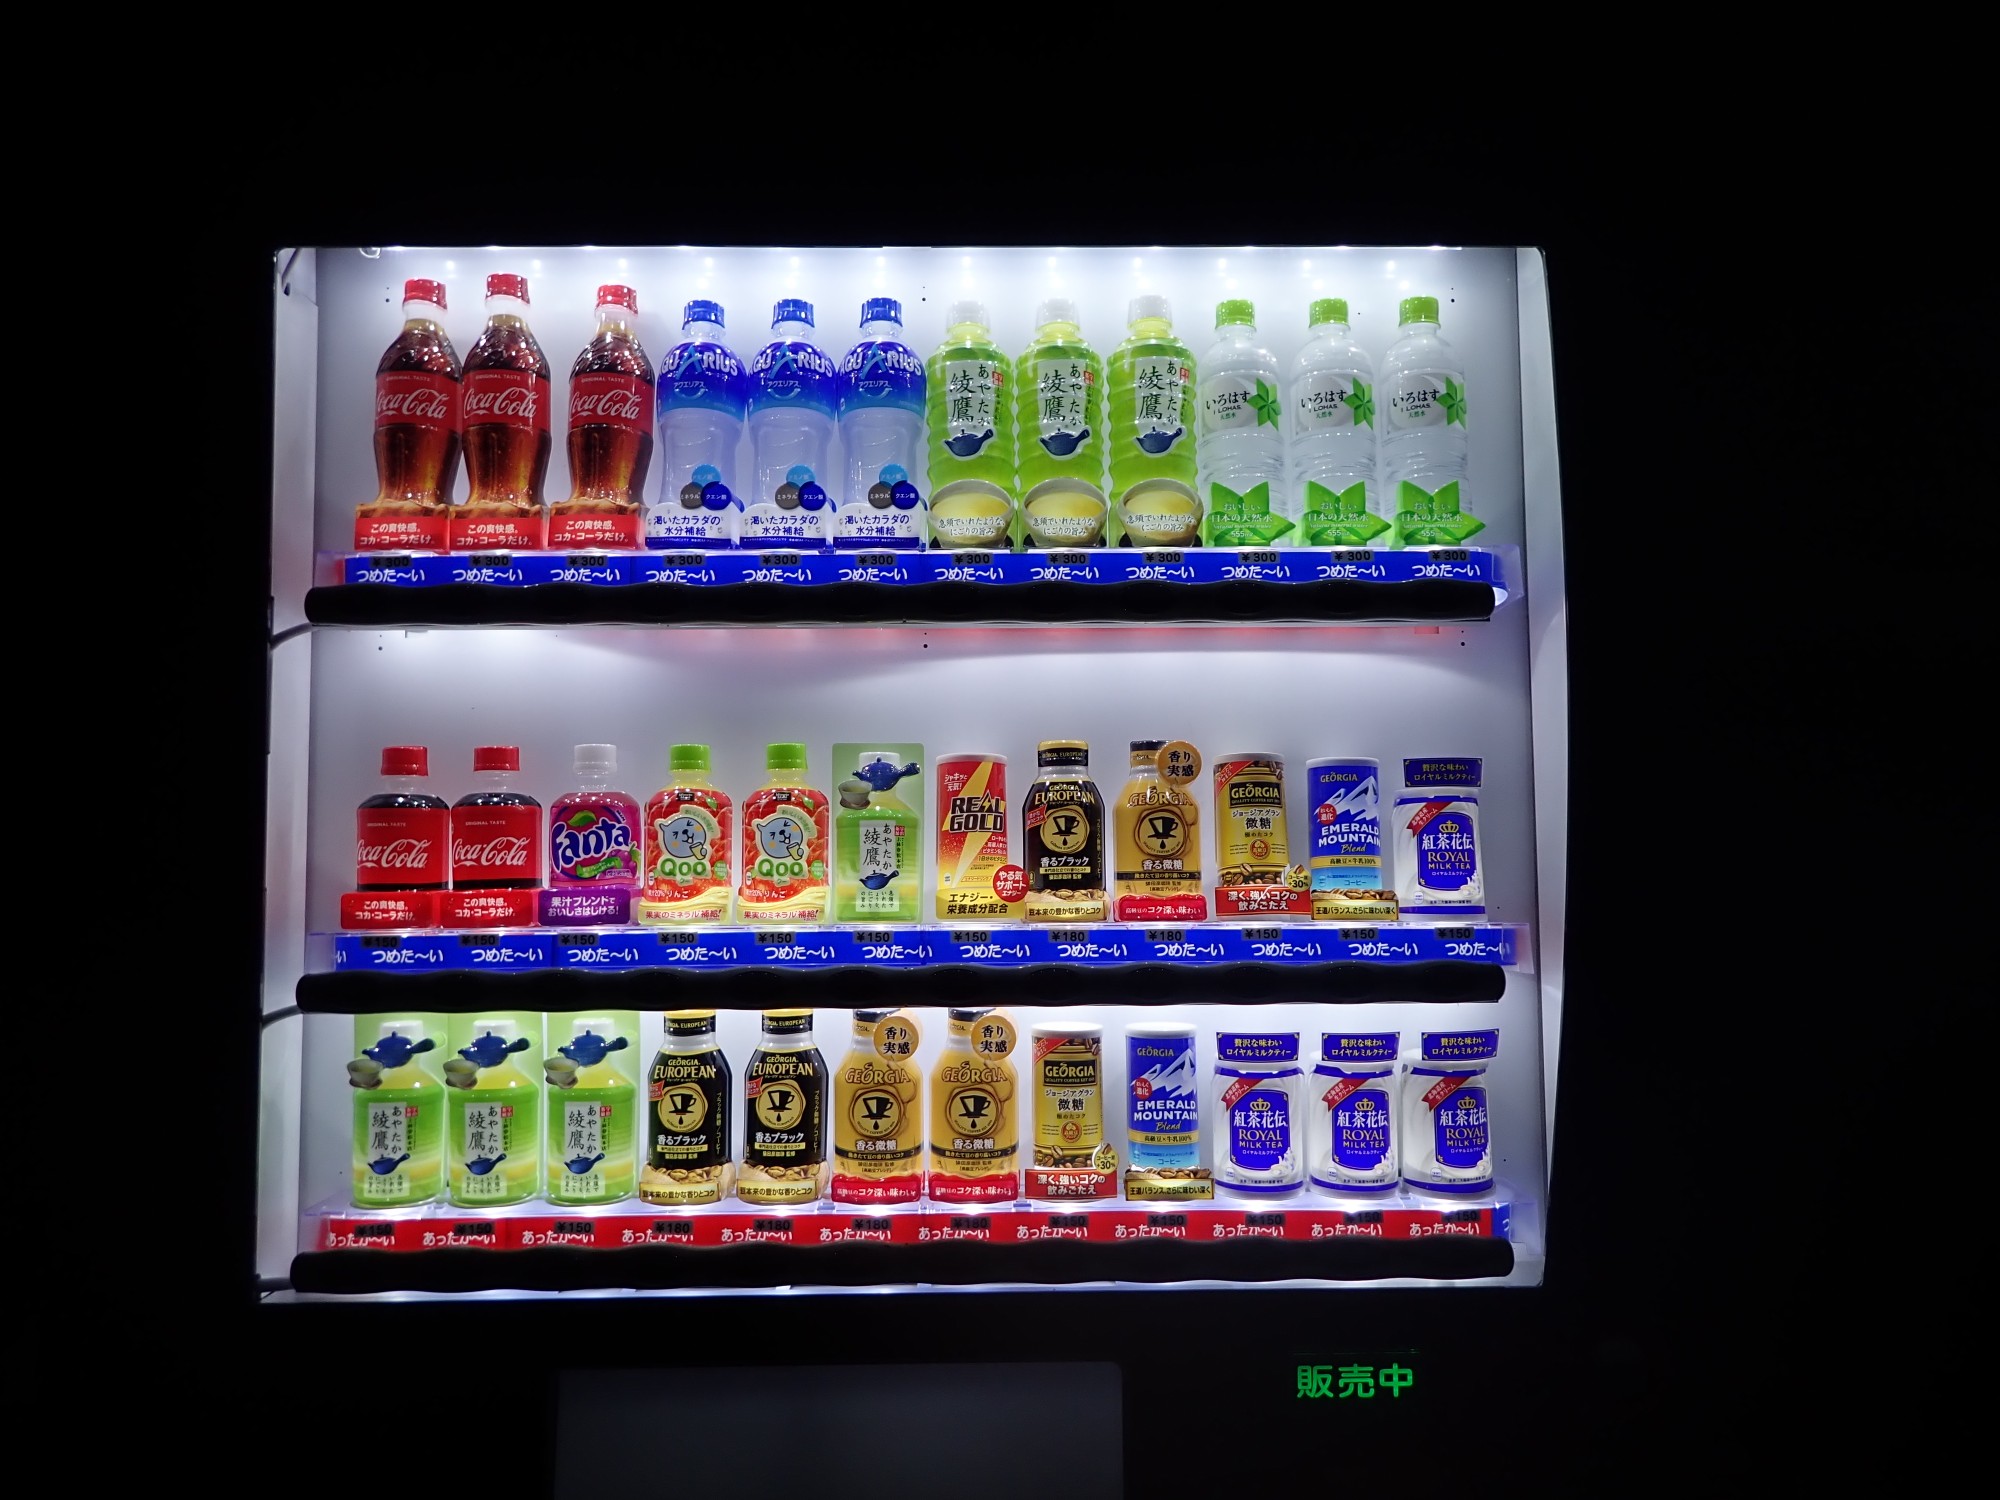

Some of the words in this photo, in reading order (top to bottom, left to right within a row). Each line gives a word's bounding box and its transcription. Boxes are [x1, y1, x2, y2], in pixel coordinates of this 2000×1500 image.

[767, 381, 800, 389] アクエリアス
[858, 380, 891, 389] アクエリアス
[949, 369, 977, 423] 綾鷹
[978, 364, 991, 426] あやたか
[1040, 370, 1067, 423] 綾鷹
[1069, 363, 1082, 425] あやたか
[1138, 366, 1166, 421] 綾鷹
[1166, 361, 1179, 424] あやたか
[1206, 391, 1250, 409] いろはす
[1301, 390, 1347, 408] いろはす
[1393, 389, 1439, 408] いろはす
[1408, 411, 1426, 419] 天然水
[1414, 501, 1451, 510] おいしい
[654, 515, 720, 526] 渇いたカラダの
[750, 515, 819, 526] 渇いたカラダの
[845, 515, 909, 526] 渇いたカラダの
[1211, 513, 1273, 523] 日本の天然水
[1308, 513, 1369, 523] 日本の天然水
[1401, 512, 1463, 522] 日本の天然水
[370, 522, 421, 533] この爽快感。
[467, 524, 519, 534] この爽快感。
[565, 520, 616, 530] この爽快感。
[664, 525, 706, 536] 水分補給
[762, 525, 804, 536] 水分補給
[856, 525, 895, 536] 水分補給
[950, 527, 995, 536] にごりの旨み
[1043, 526, 1086, 536] にごりの旨み
[372, 556, 409, 567] ¥300
[569, 556, 605, 566] ¥300
[667, 555, 703, 565] ¥300
[858, 555, 893, 565] ¥300
[954, 554, 990, 564] ¥300
[1145, 553, 1181, 563] ¥300
[1242, 553, 1276, 563] ¥300
[1334, 552, 1371, 562] ¥300
[1432, 551, 1467, 561] ¥300
[1168, 750, 1191, 763] 香り
[1167, 765, 1194, 777] 実感
[1422, 763, 1469, 772] 贅沢な味わい
[1320, 771, 1358, 783] GEORGIA
[1414, 772, 1477, 781] ロイヤルミルクティー
[1129, 785, 1193, 806] GEORGIA
[1231, 785, 1280, 798] GEORGIA
[951, 793, 1004, 815] REAL
[1035, 792, 1095, 805] EUROPEAN
[1321, 812, 1333, 821] 進化
[950, 813, 1003, 832] GOLD
[1246, 818, 1271, 830] 微糖
[1321, 823, 1379, 835] EMERALD
[1318, 834, 1380, 847] MOUNTAIN
[1422, 833, 1474, 850] 紅茶花伝
[453, 837, 531, 866] Coca-Cola
[551, 821, 631, 872] Fanta
[863, 829, 881, 866] 綾鷹
[882, 824, 892, 871] あやたか
[1341, 844, 1366, 853] Blend
[1040, 856, 1089, 866] 香るブラック
[1427, 852, 1470, 862] ROYAL
[660, 859, 706, 877] Qoo
[757, 859, 804, 877] Qoo
[1142, 860, 1183, 870] 香る微糖
[1428, 862, 1450, 870] MILK
[999, 871, 1023, 881] やる気
[996, 881, 1026, 890] サポート
[764, 889, 785, 898] りんご
[1228, 891, 1297, 902] 深く、強いコクの
[363, 900, 408, 911] この爽快感。
[464, 898, 508, 907] この爽快感。
[551, 896, 615, 907] 果汁ブレンドで
[1239, 901, 1288, 911] 飲みごたえ
[947, 904, 1009, 914] 栄養成分配合
[661, 934, 695, 944] ¥150
[758, 933, 792, 944] ¥150
[954, 932, 987, 942] ¥150
[1052, 931, 1084, 941] ¥180
[1149, 931, 1182, 941] ¥180
[1246, 929, 1278, 939] ¥150
[562, 935, 595, 945] ¥150
[982, 1025, 1004, 1038] 香り
[980, 1041, 1007, 1053] 実感
[1234, 1038, 1281, 1048] 贅沢な味わい
[1441, 1036, 1486, 1047] 贅沢な味わい
[1137, 1046, 1174, 1056] GEORGIA
[1226, 1048, 1291, 1057] ロイヤルミルクティー
[1432, 1046, 1492, 1056] ロイヤルミルクティー
[668, 1054, 700, 1066] GEORGIA
[654, 1065, 715, 1078] EUROPEAN
[753, 1063, 813, 1076] EUROPEAN
[845, 1064, 910, 1084] GEORGIA
[942, 1061, 1007, 1083] GEORGIA
[1045, 1062, 1095, 1077] GEORGIA
[1058, 1098, 1083, 1110] 微糖
[1137, 1100, 1196, 1110] EMERALD
[1134, 1111, 1198, 1122] MOUNTAIN
[1234, 1109, 1288, 1128] 紅茶花伝
[1337, 1109, 1388, 1127] 紅茶花伝
[1440, 1108, 1486, 1127] 紅茶花伝
[372, 1112, 389, 1151] 綾鷹
[392, 1106, 402, 1154] あやたか
[567, 1111, 584, 1150] 綾鷹
[587, 1105, 597, 1154] あやたか
[1239, 1129, 1282, 1141] ROYAL
[1343, 1129, 1385, 1141] ROYAL
[658, 1134, 706, 1144] 香るブラック
[953, 1138, 993, 1149] 香る微糖
[1343, 1141, 1365, 1149] MILK
[1368, 1140, 1385, 1148] TEA
[1038, 1175, 1105, 1185] 深く、強いコクの
[1047, 1185, 1097, 1195] 飲みごたえ
[756, 1220, 790, 1231] ¥180
[855, 1219, 889, 1230] ¥180
[1150, 1215, 1183, 1226] ¥150
[557, 1222, 592, 1233] ¥150
[1297, 1362, 1413, 1398] 販売中
